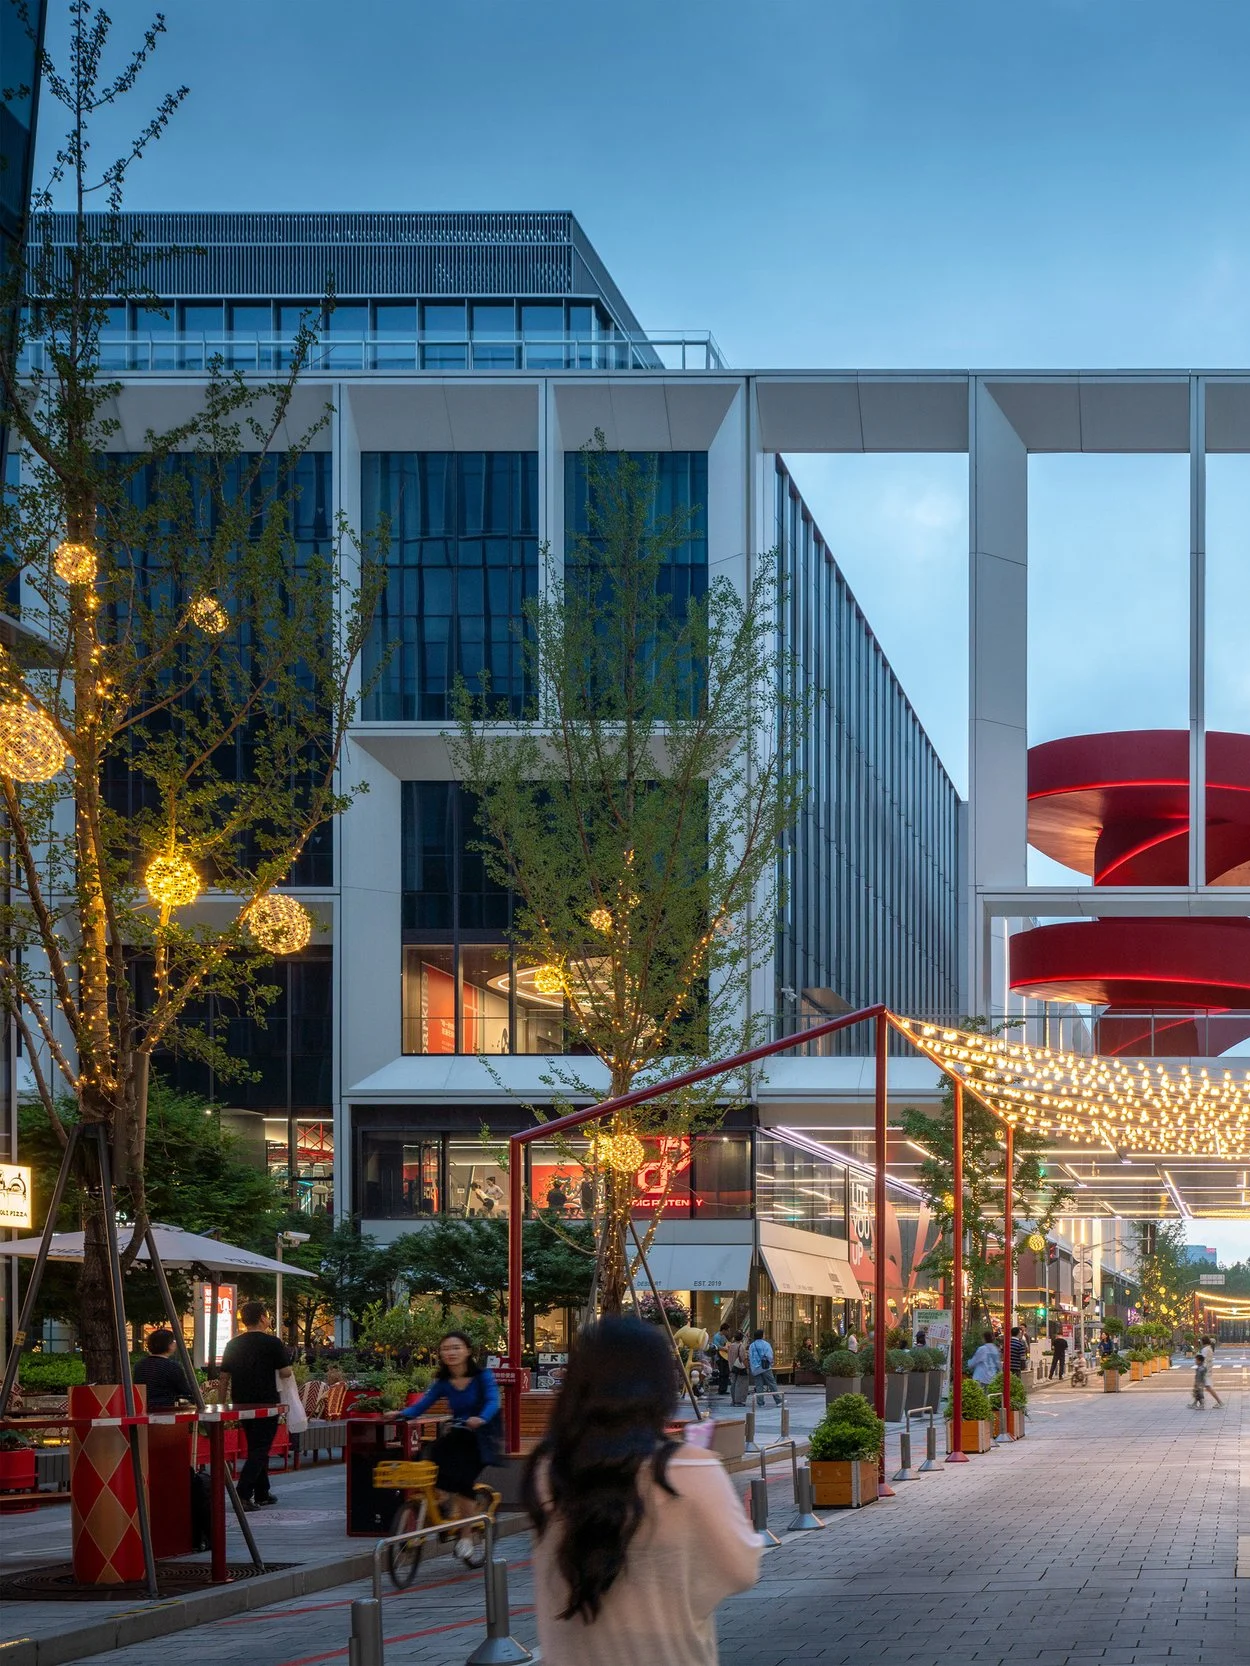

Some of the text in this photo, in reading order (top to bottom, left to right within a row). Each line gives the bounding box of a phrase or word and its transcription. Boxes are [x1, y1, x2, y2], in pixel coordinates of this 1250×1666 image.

[651, 1199, 703, 1207] PTENY
[851, 1214, 870, 1240] YOU
[852, 1241, 864, 1265] UP
